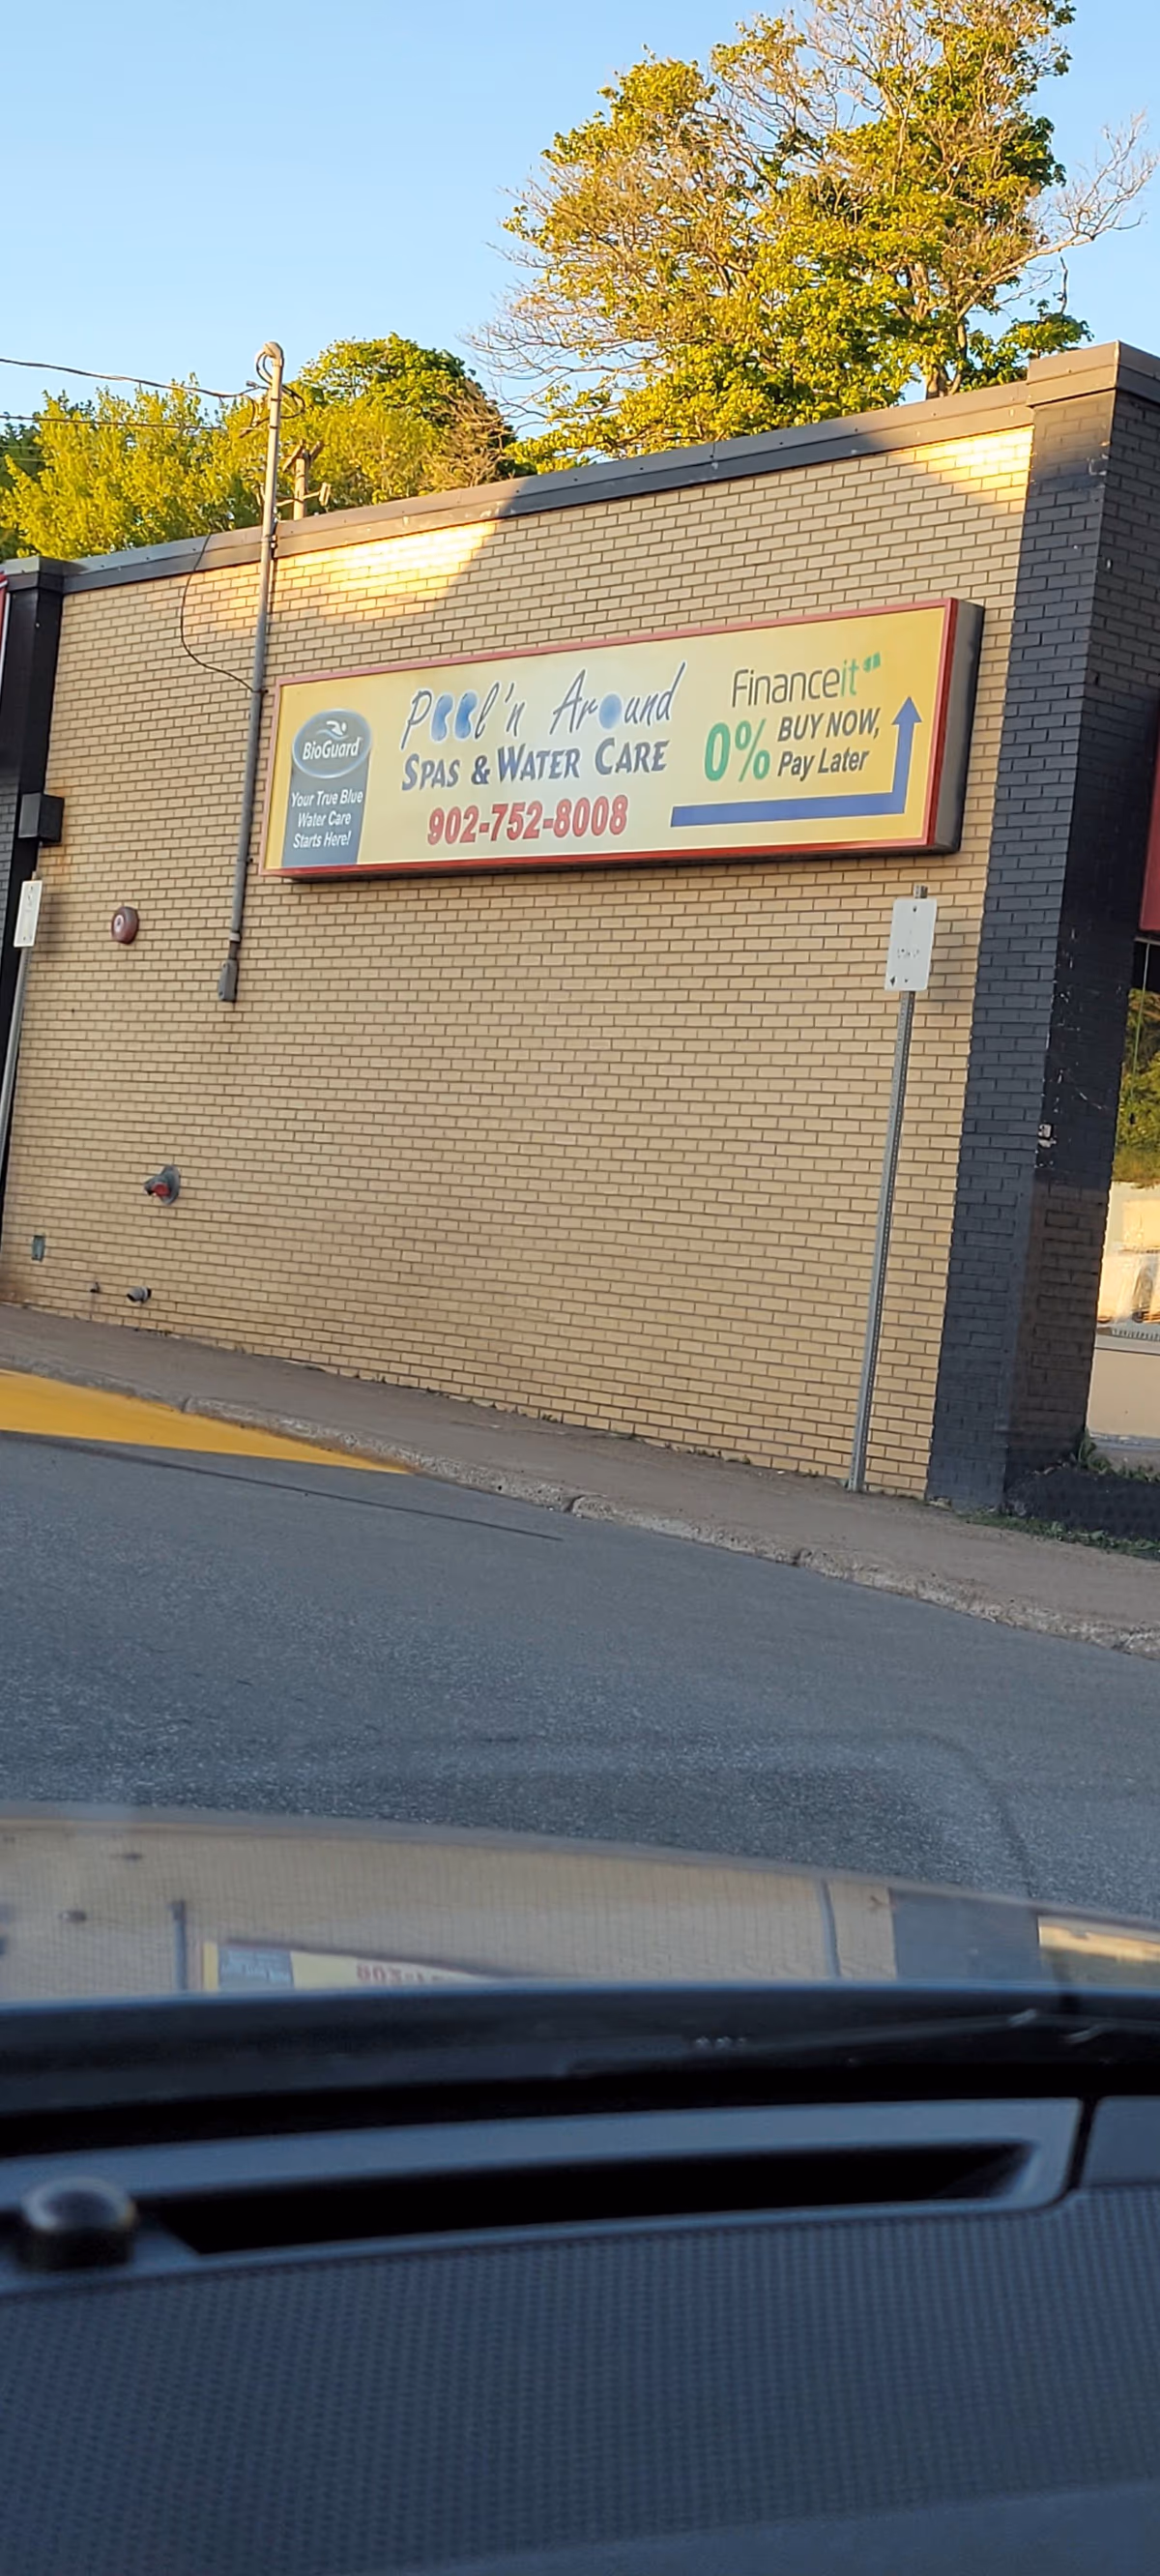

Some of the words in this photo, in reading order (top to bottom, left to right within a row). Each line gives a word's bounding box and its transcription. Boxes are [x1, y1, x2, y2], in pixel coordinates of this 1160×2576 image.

[549, 661, 686, 735] Around
[732, 659, 858, 708] Financeit
[777, 713, 824, 743] BUY
[826, 707, 881, 739] NOW,
[302, 736, 361, 760] BioGuard
[401, 753, 460, 791] SPAS
[471, 755, 491, 785] &
[497, 743, 581, 783] WATER
[594, 737, 670, 776] CARE
[704, 718, 770, 782] 0%
[777, 750, 815, 781] Pay
[818, 746, 870, 774] Later
[291, 791, 314, 808] Your
[316, 790, 338, 806] True
[339, 788, 363, 805] Blue
[298, 811, 327, 828] Water
[328, 809, 352, 827] Care
[427, 794, 628, 846] 902-752-8008
[293, 833, 323, 849] Starts
[324, 830, 352, 847] Here!
